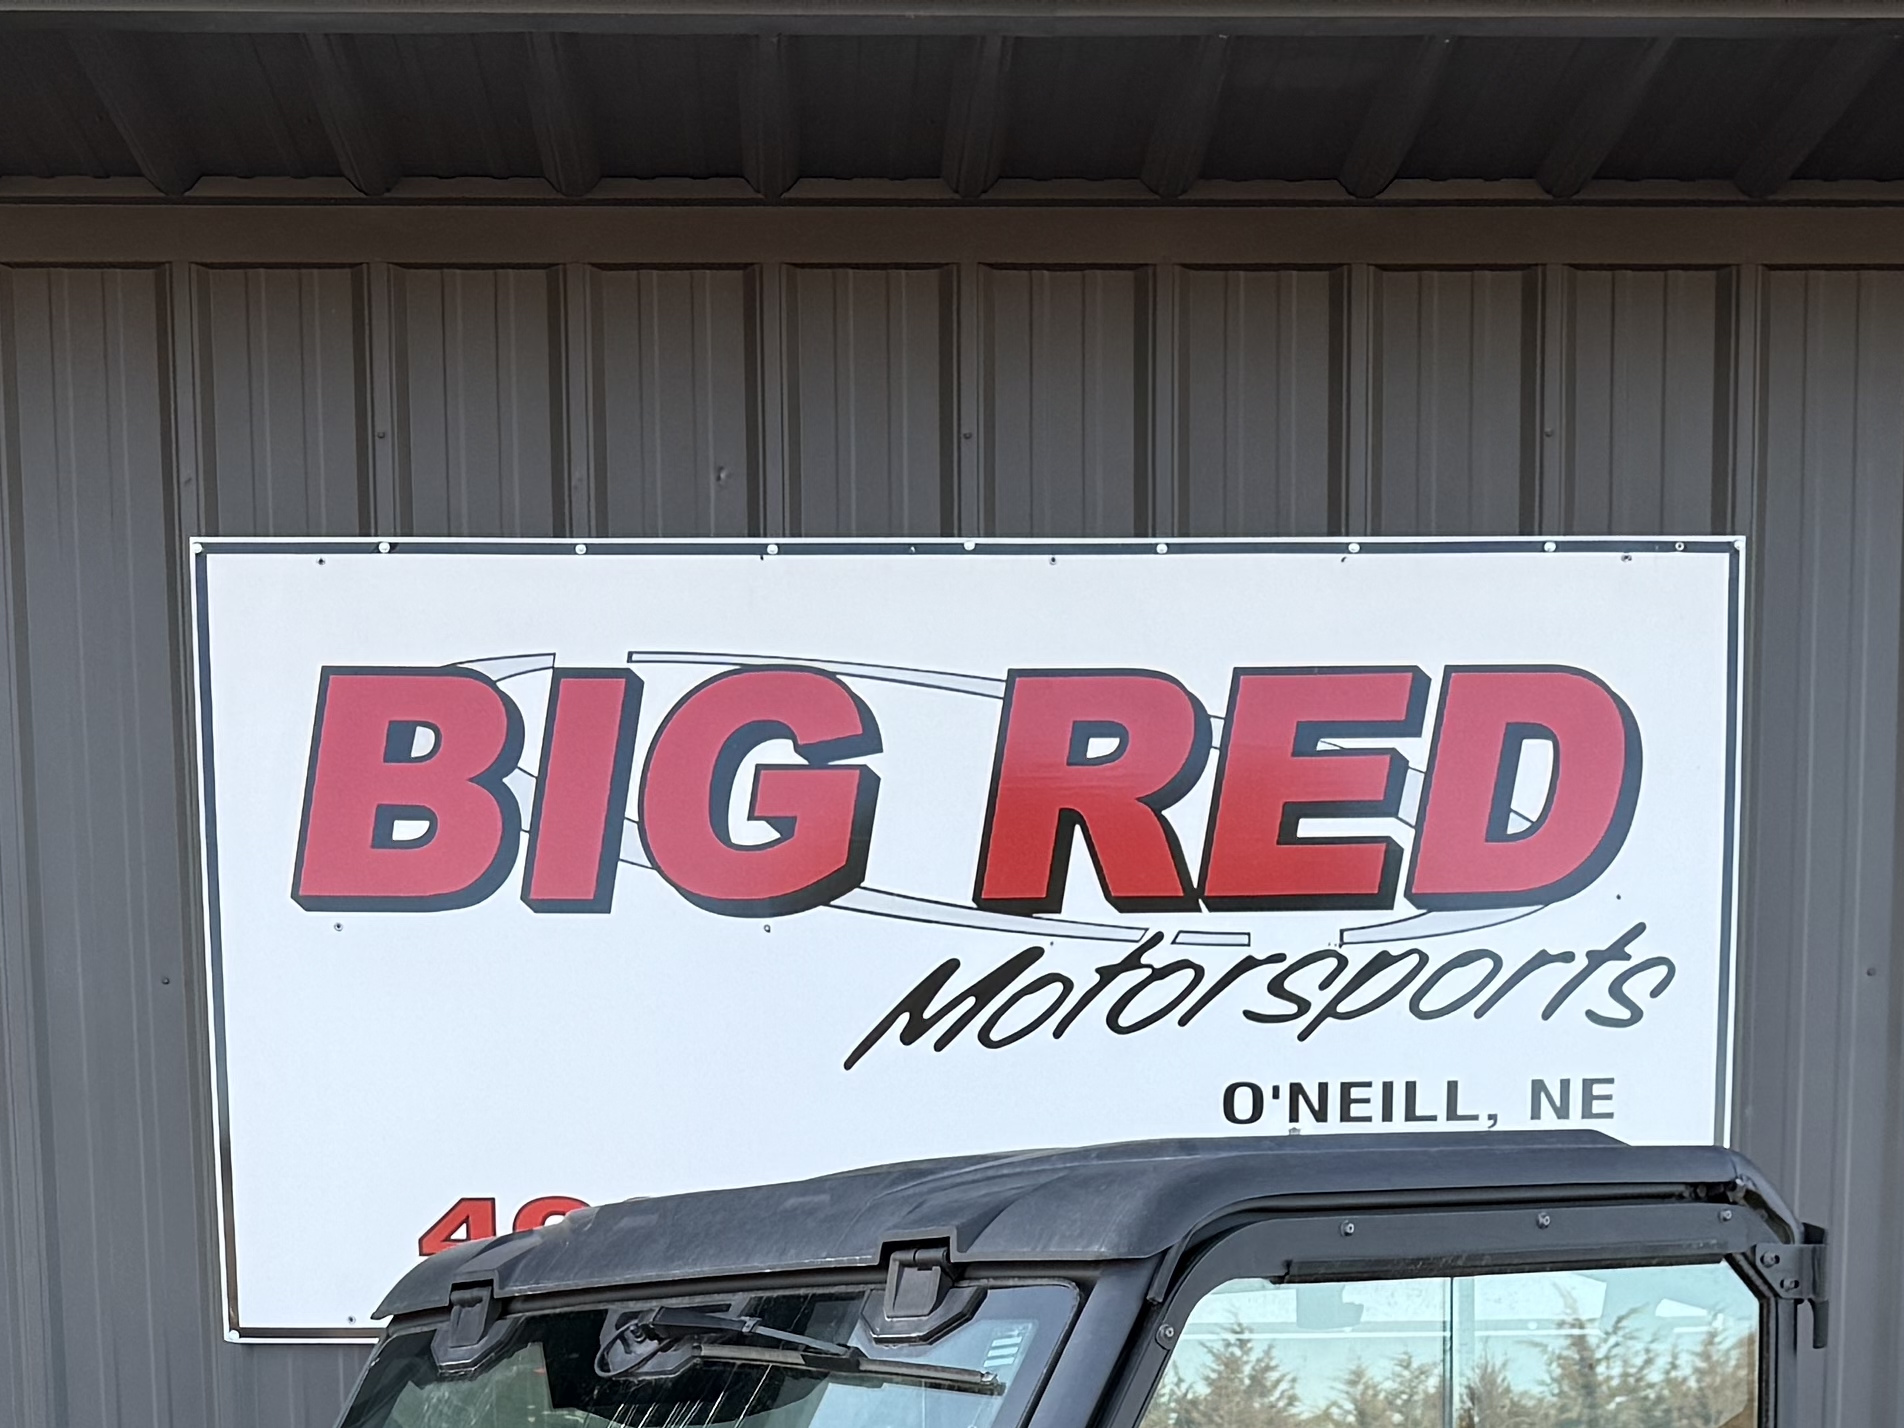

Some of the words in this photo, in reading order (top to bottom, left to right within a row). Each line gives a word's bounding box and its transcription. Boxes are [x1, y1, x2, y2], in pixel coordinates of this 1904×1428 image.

[291, 664, 883, 914] BIG
[973, 664, 1642, 914] RED
[843, 921, 1676, 1071] Motorsports
[1222, 1079, 1499, 1127] O'NEILL,
[1529, 1077, 1617, 1120] NE
